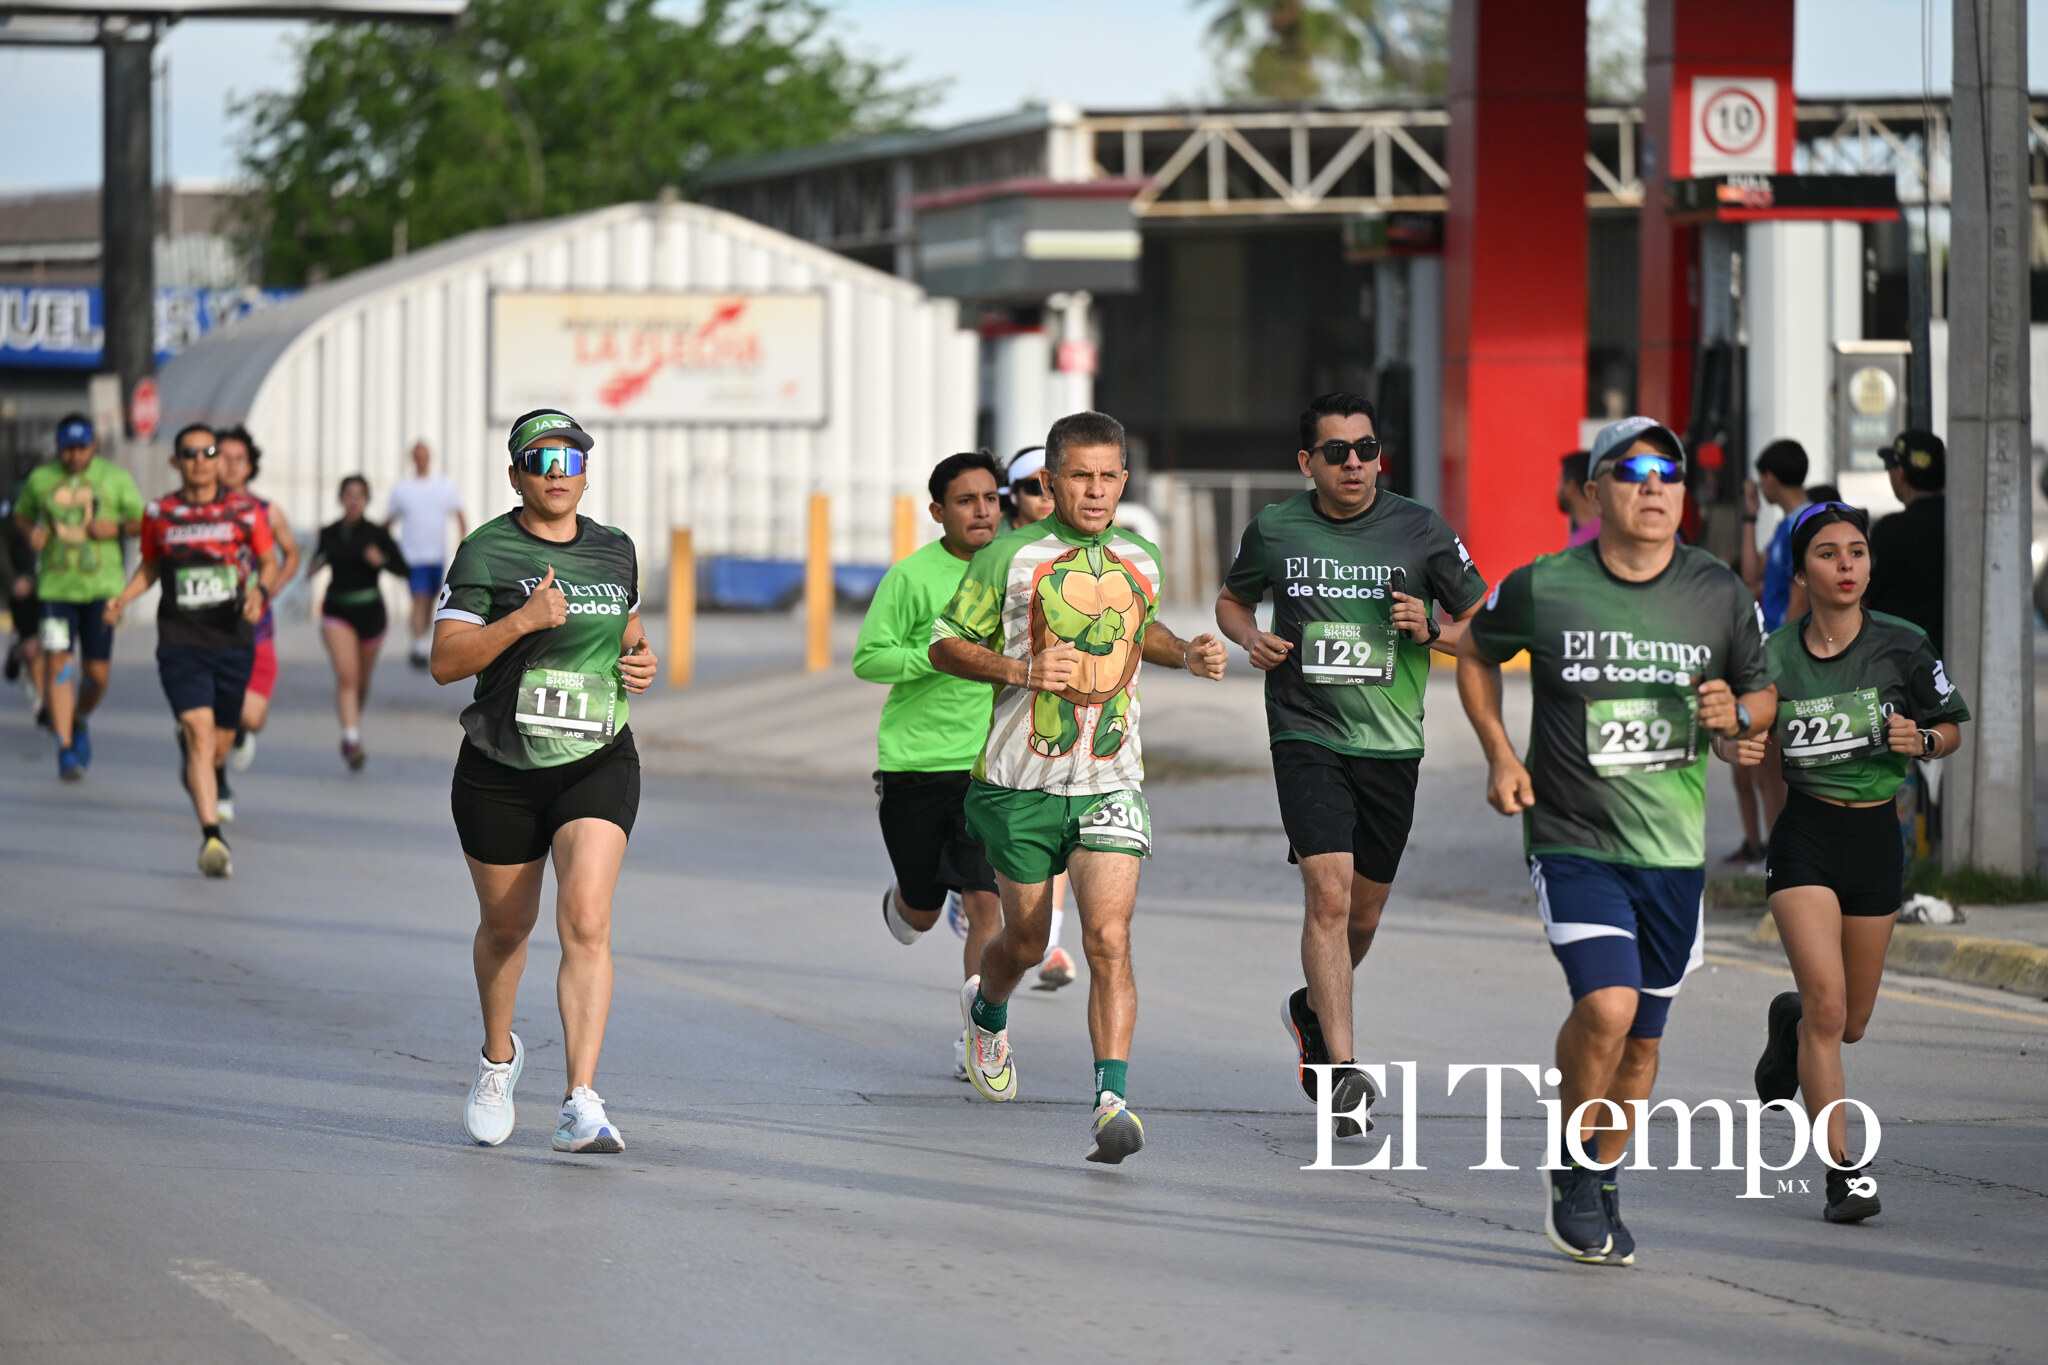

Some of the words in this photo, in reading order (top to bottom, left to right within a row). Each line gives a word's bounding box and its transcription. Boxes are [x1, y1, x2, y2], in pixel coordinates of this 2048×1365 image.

[1718, 104, 1751, 133] 10
[1284, 557, 1309, 579] El
[517, 577, 542, 597] E
[1287, 583, 1314, 597] de
[1317, 584, 1384, 599] todos
[1314, 640, 1371, 666] 129
[1385, 640, 1394, 680] MEDALLA
[1562, 630, 1596, 660] El
[1600, 630, 1711, 671] Tiempo
[1561, 663, 1600, 682] de
[1603, 664, 1691, 687] todos
[534, 687, 588, 719] 111
[1862, 692, 1876, 700] 222
[606, 692, 615, 736] MEDALLA
[1867, 703, 1881, 746] MEDALLA
[1600, 719, 1672, 753] 239
[1788, 713, 1853, 746] 222
